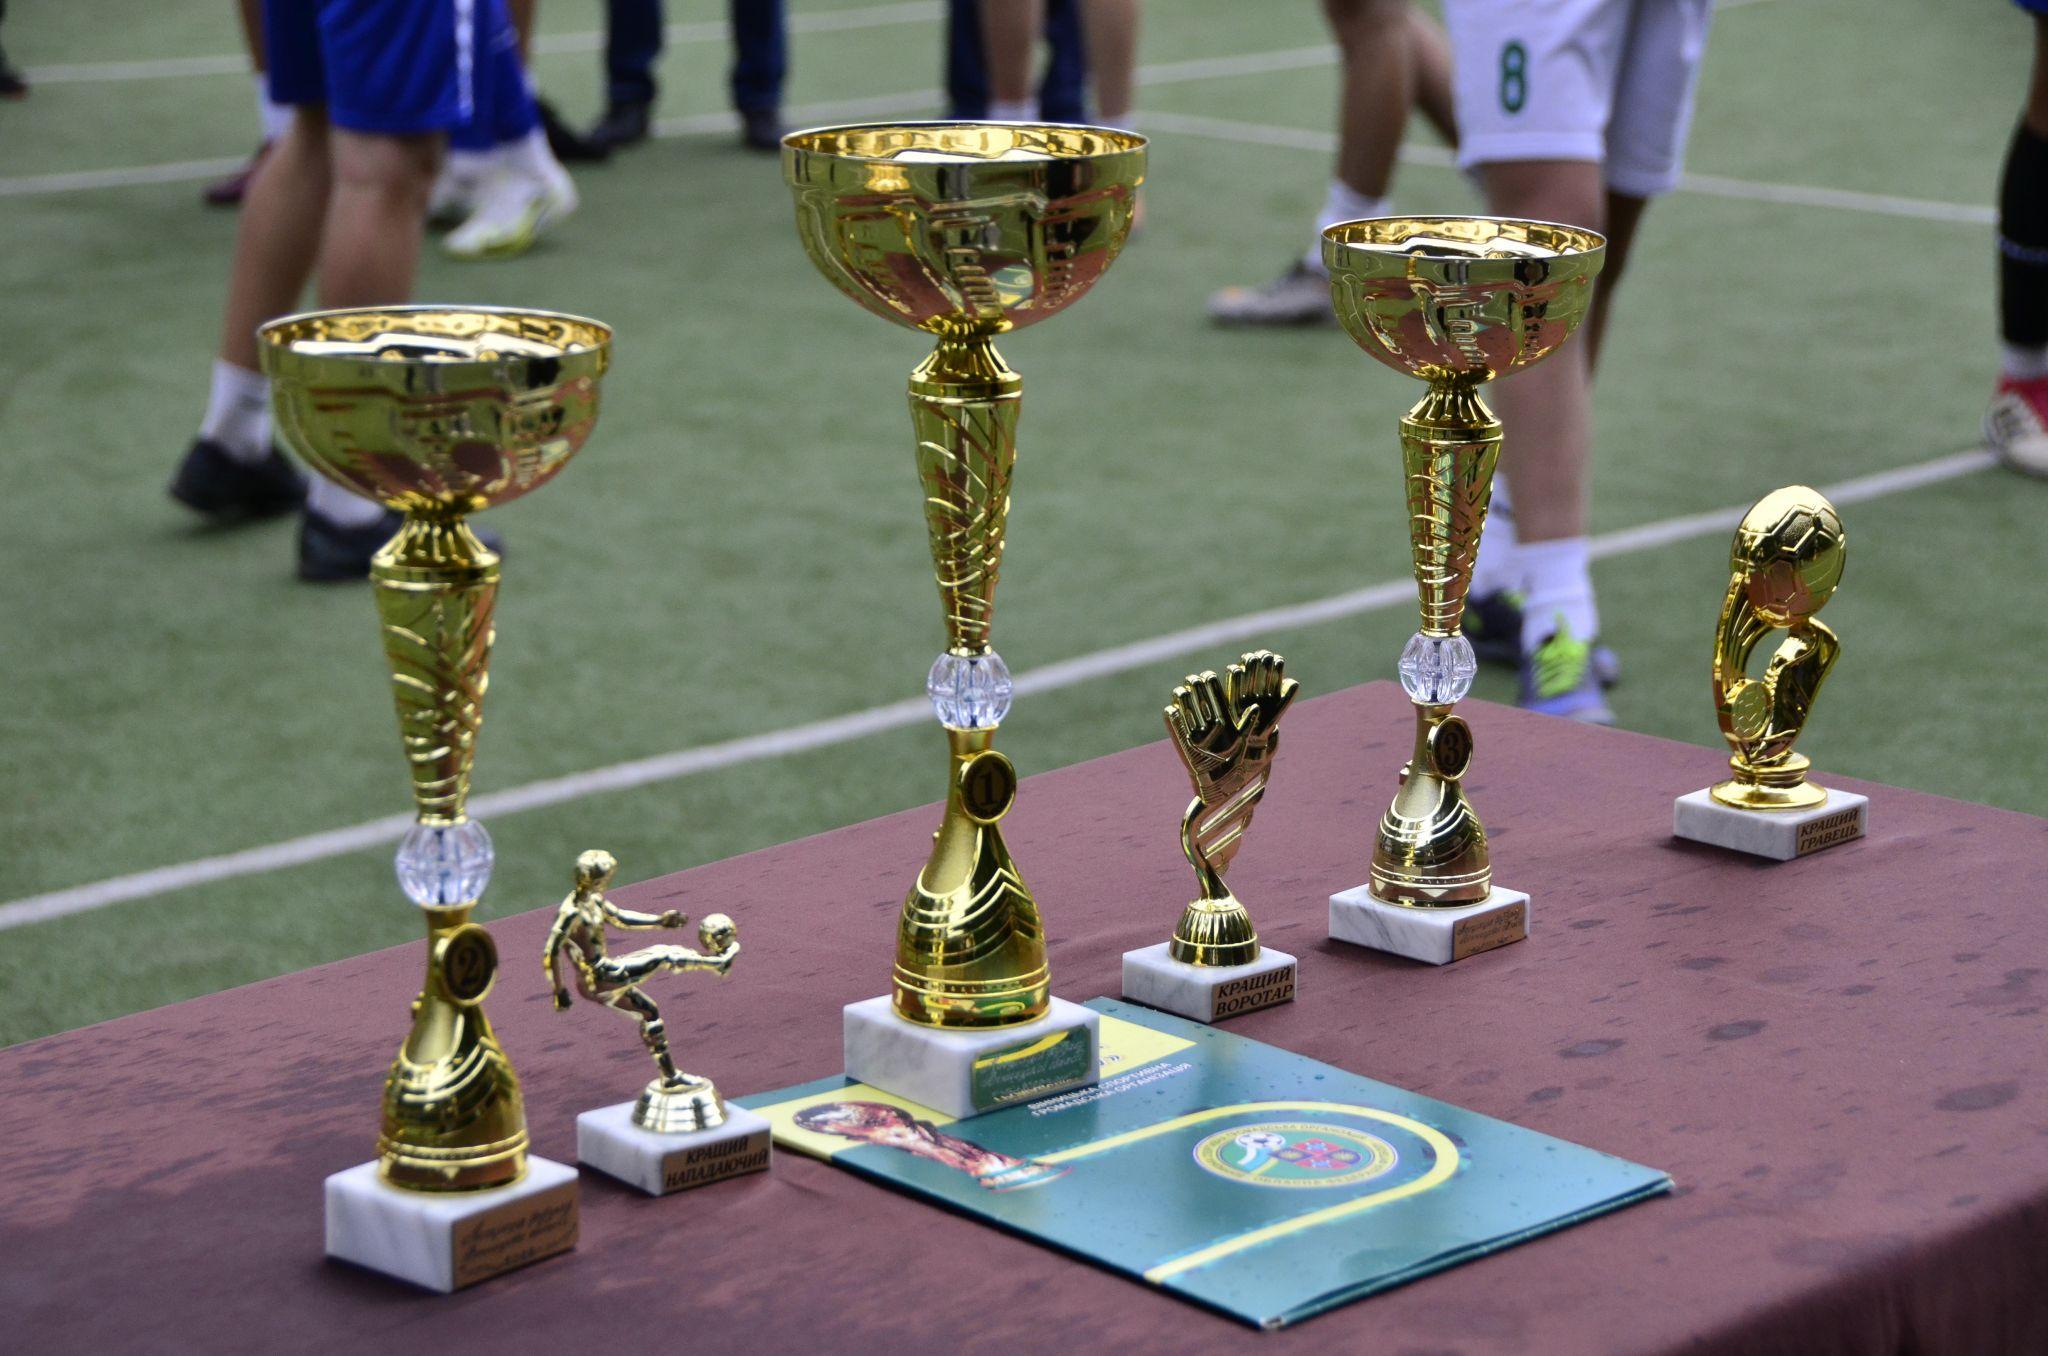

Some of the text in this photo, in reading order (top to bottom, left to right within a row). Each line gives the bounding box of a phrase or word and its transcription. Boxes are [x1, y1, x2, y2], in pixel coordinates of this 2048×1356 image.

[1500, 40, 1526, 115] 8
[1443, 732, 1460, 767] 3
[979, 769, 996, 805] 1
[1800, 807, 1859, 838] КРАЩИЙ
[1800, 824, 1858, 852] ГРАВЕЦЬ
[458, 946, 480, 986] 2
[1217, 965, 1291, 999] КРАЩИЙ
[1215, 984, 1294, 1016] ВОРОТАР
[686, 1134, 750, 1165] КРАЩИЙ
[666, 1147, 769, 1188] НАПАДАЮЧИЙ
